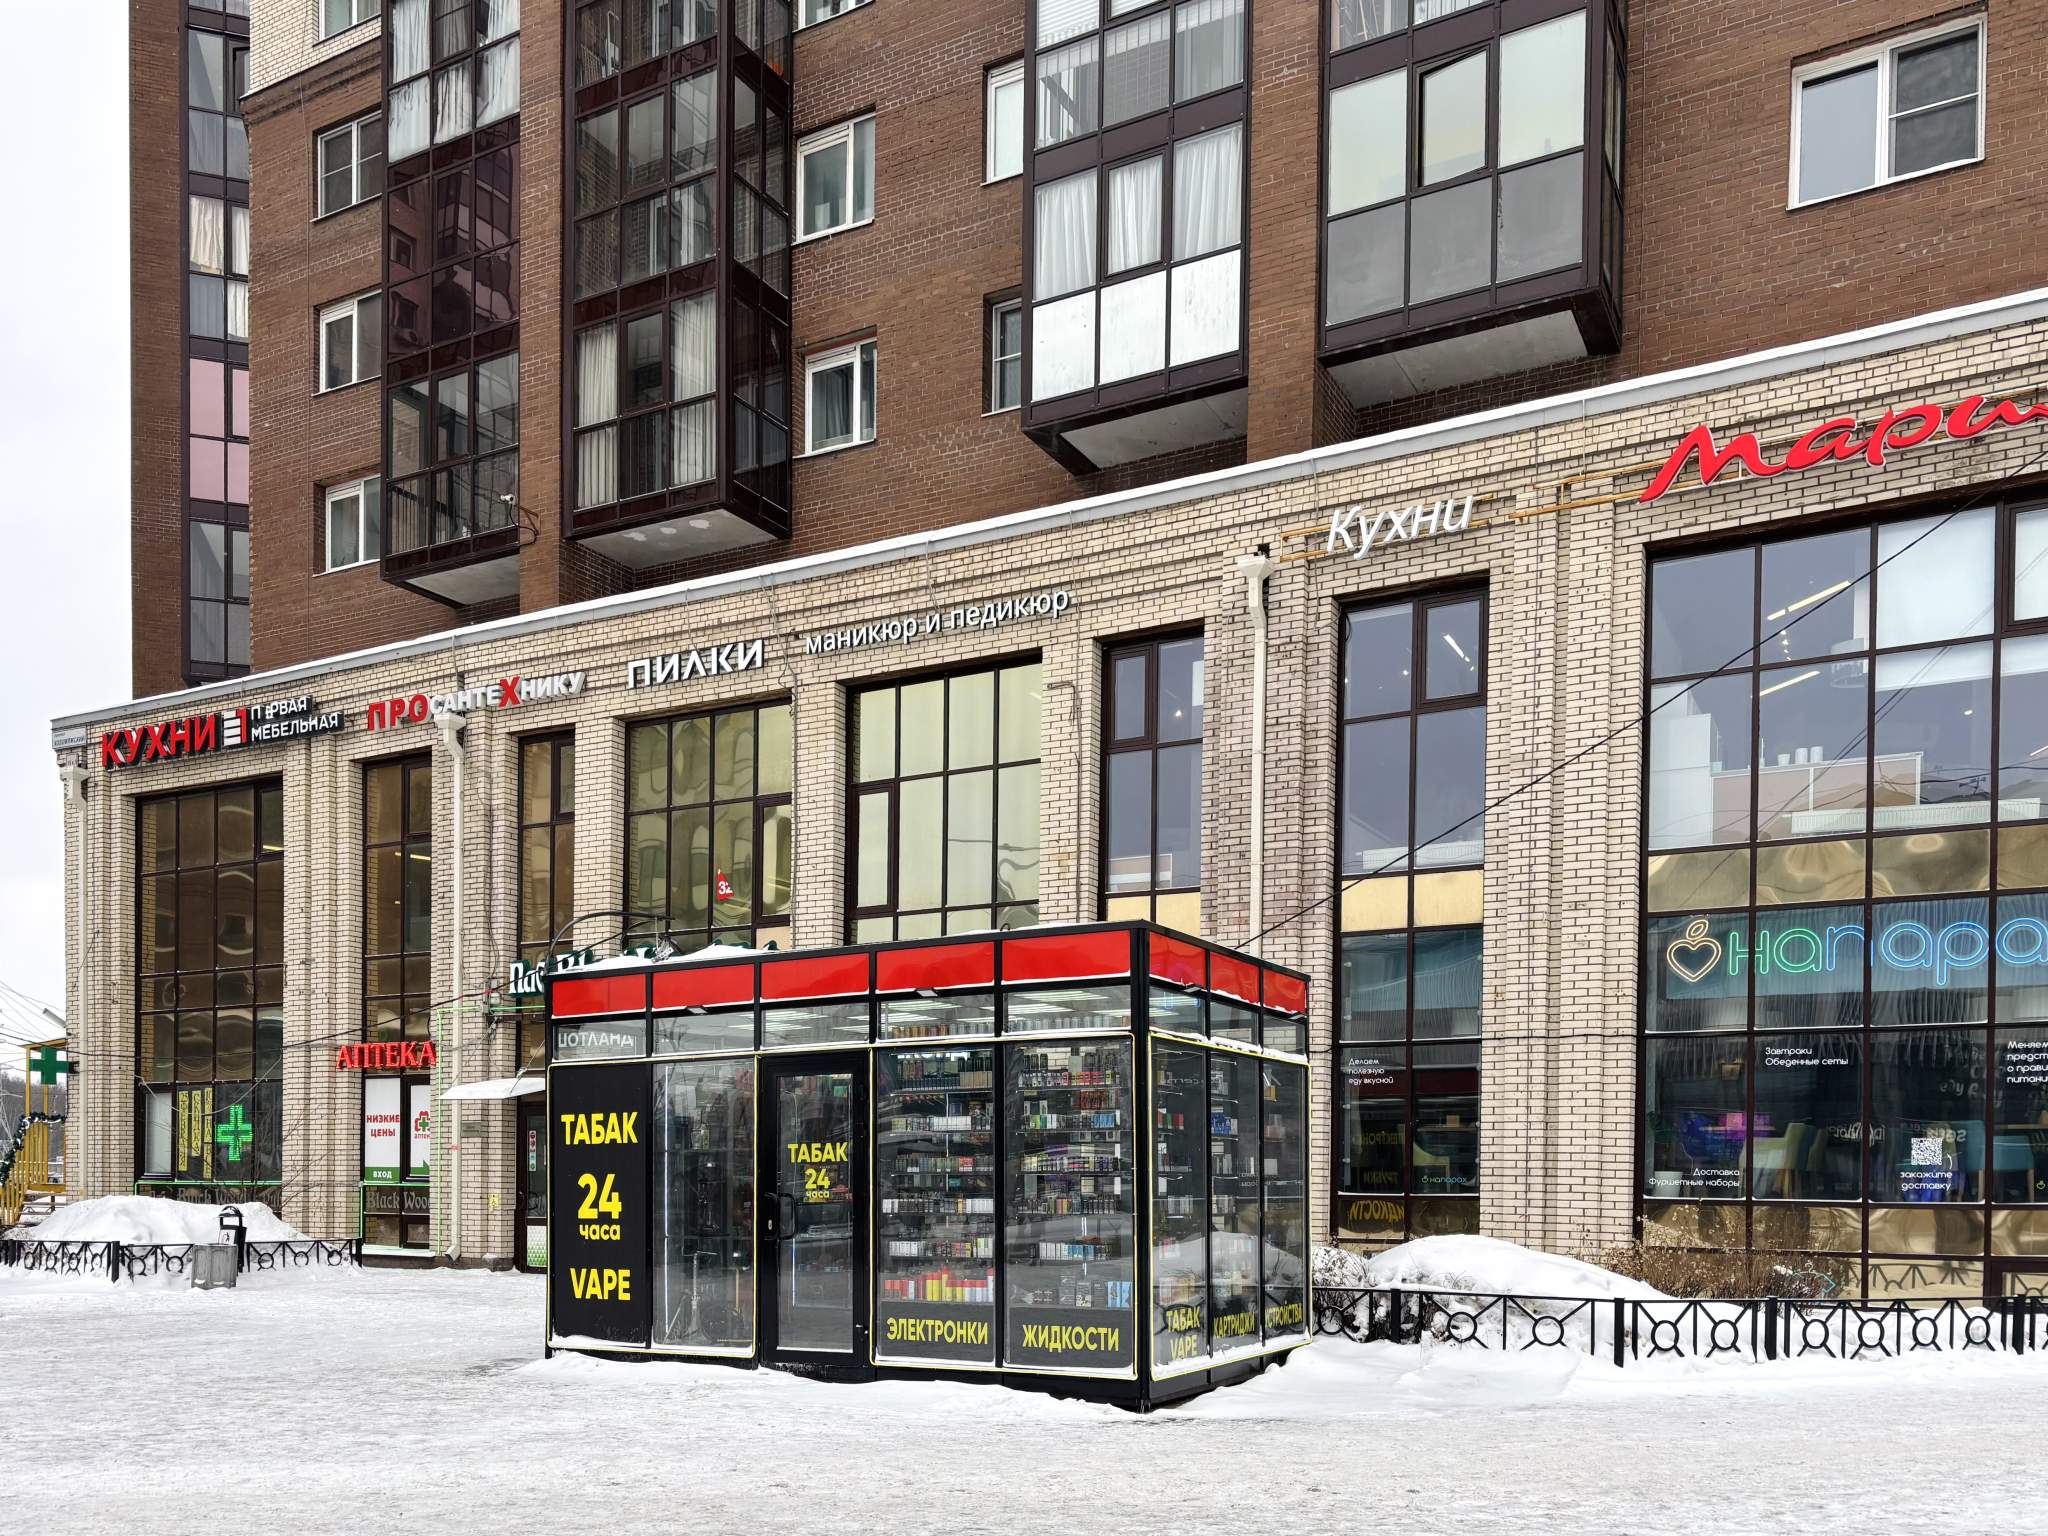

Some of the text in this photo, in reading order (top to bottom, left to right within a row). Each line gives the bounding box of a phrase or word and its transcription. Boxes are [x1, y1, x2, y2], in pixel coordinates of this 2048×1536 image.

[1326, 495, 1476, 560] Кухни
[806, 590, 1070, 655] маникюр и педикюр
[627, 639, 765, 689] ПИЛКИ
[101, 712, 220, 770] КУХНИ
[250, 711, 340, 743] МЕБЕЛЬНАЯ
[336, 1040, 437, 1070] АПТЕКА
[366, 1114, 400, 1124] НИЗКИЕ
[561, 1111, 638, 1145] ТАБАК
[370, 1129, 396, 1138] ЦЕНЫ
[787, 1141, 848, 1163] ТАБАК
[805, 1168, 830, 1189] 24
[1693, 1167, 1740, 1177] Доставка
[366, 1191, 400, 1209] Black
[577, 1173, 622, 1219] 24
[805, 1190, 830, 1199] часа
[579, 1224, 621, 1240] часа
[570, 1267, 631, 1301] VAPE
[886, 1317, 988, 1345] ЭЛЕКТРОНКИ
[1166, 1306, 1201, 1333] ТАБАК
[1023, 1324, 1120, 1353] ЖИДКОСТИ
[1170, 1334, 1198, 1360] VAPE
